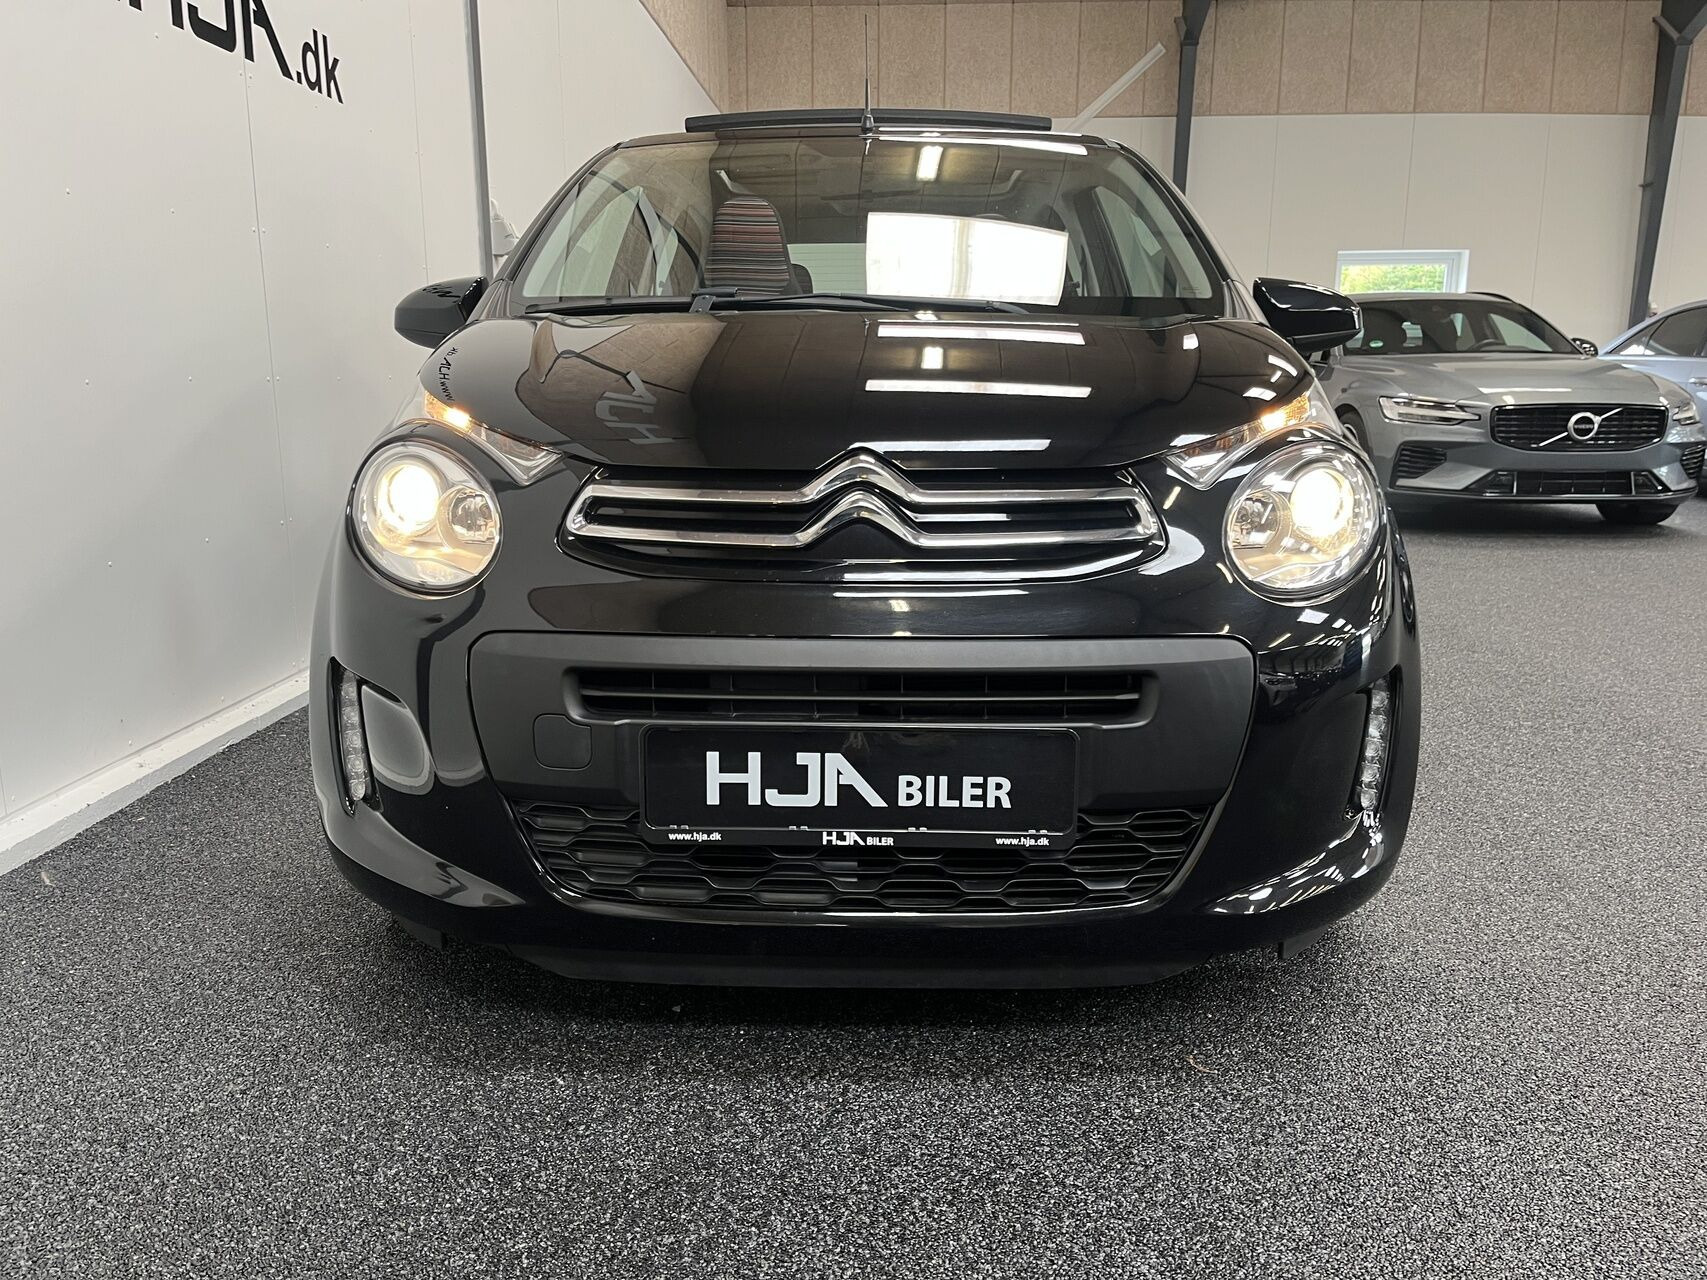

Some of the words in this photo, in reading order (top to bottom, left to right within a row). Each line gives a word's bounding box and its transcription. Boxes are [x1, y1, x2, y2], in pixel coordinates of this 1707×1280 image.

[128, 0, 343, 104] JA.dk
[706, 751, 888, 807] HJA
[898, 775, 1012, 809] BILER
[668, 831, 722, 842] www.hja.dk
[822, 831, 866, 846] HJA
[866, 836, 894, 846] BILER
[995, 836, 1050, 847] www.hja.dk
